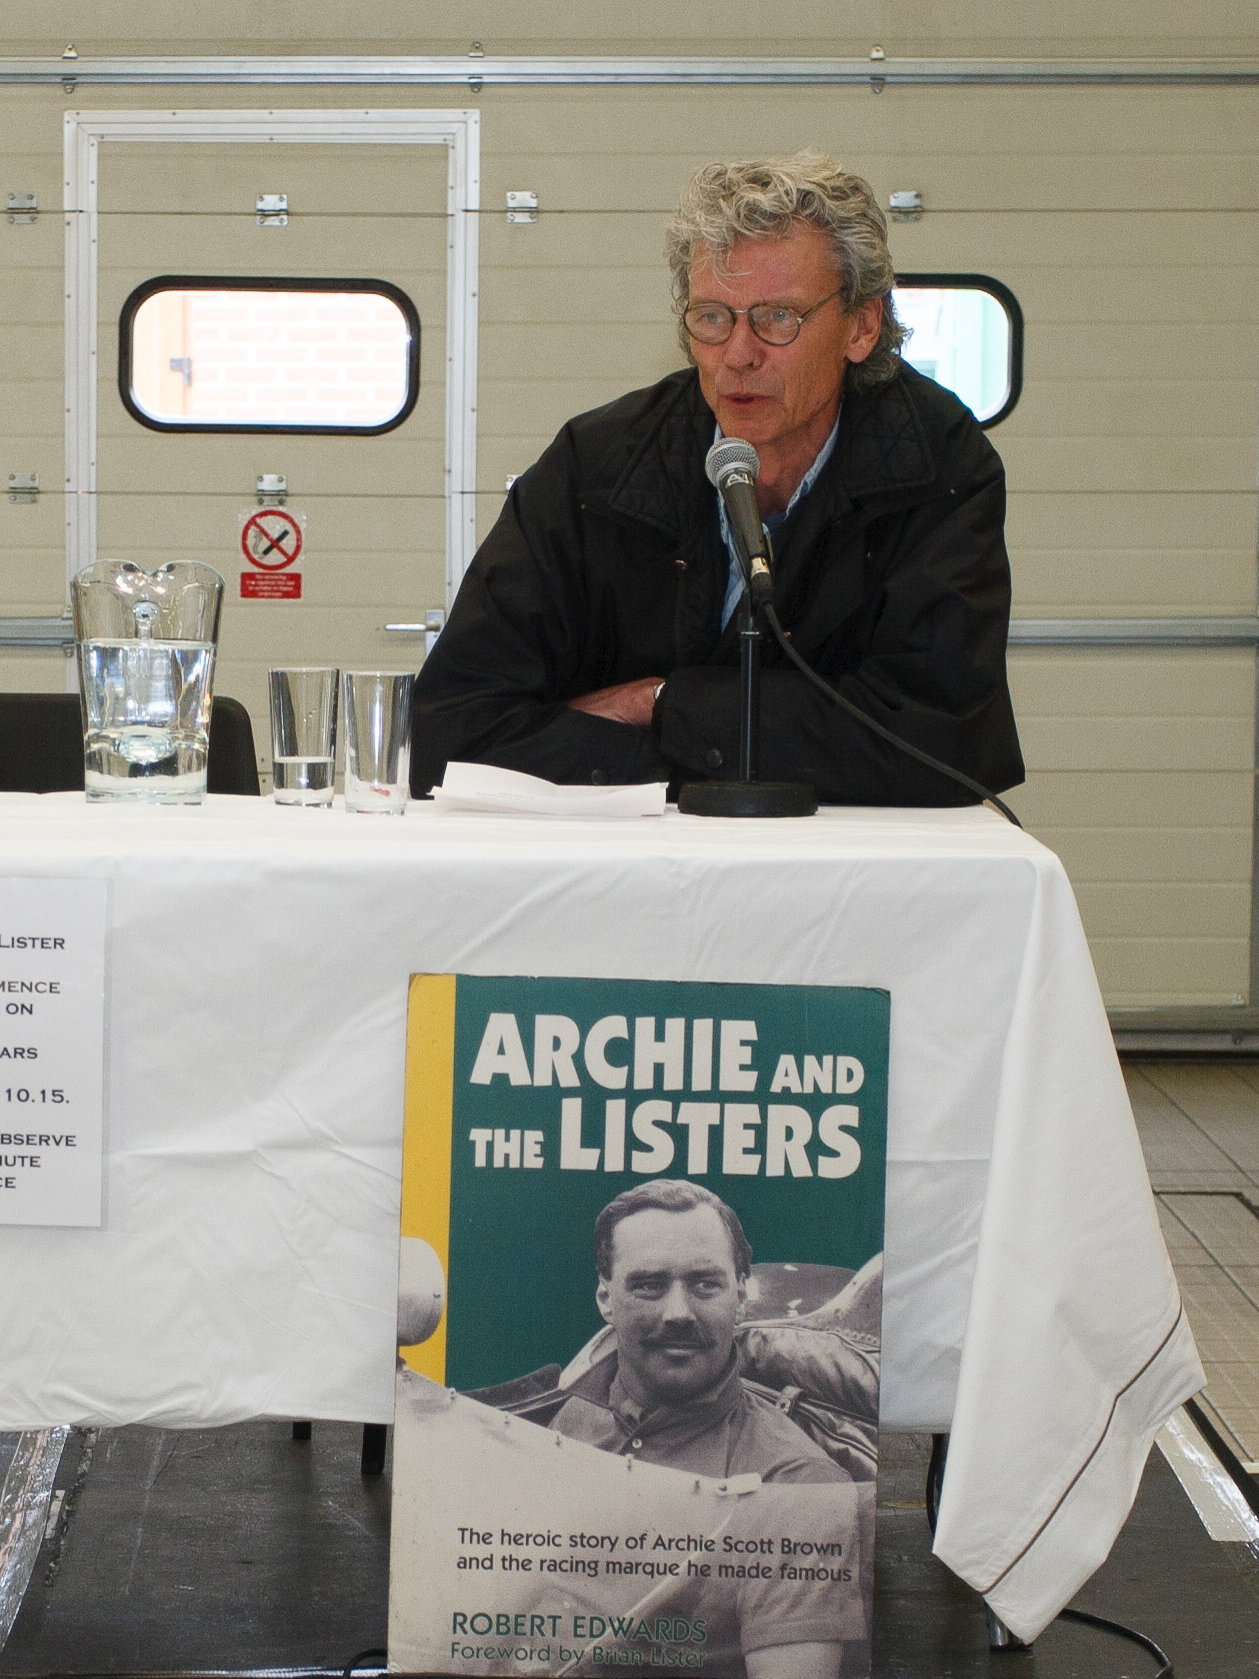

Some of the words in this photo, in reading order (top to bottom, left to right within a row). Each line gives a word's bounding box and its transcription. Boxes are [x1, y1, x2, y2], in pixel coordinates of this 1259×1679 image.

[5, 1002, 34, 1016] ON
[469, 1012, 758, 1092] ARCHIE
[770, 1054, 865, 1094] AND
[5, 1088, 70, 1104] 10.15.
[469, 1128, 544, 1168] THE
[560, 1098, 862, 1179] LISTERS
[458, 1527, 492, 1546] The
[500, 1528, 562, 1548] heroic
[569, 1531, 618, 1553] story
[625, 1533, 647, 1551] of
[652, 1534, 715, 1553] Archie
[723, 1535, 774, 1555] Scott
[780, 1538, 841, 1557] Brown
[457, 1553, 493, 1571] and
[501, 1554, 533, 1573] the
[540, 1556, 598, 1577] racing
[605, 1558, 680, 1580] marque
[687, 1560, 711, 1577] he
[718, 1561, 772, 1580] made
[779, 1562, 852, 1582] famous
[453, 1612, 561, 1639] ROBERT
[573, 1615, 707, 1642] EDWARDS
[451, 1642, 550, 1663] Foreword
[559, 1643, 585, 1666] by
[592, 1646, 642, 1666] Brian
[652, 1648, 706, 1667] Lister
